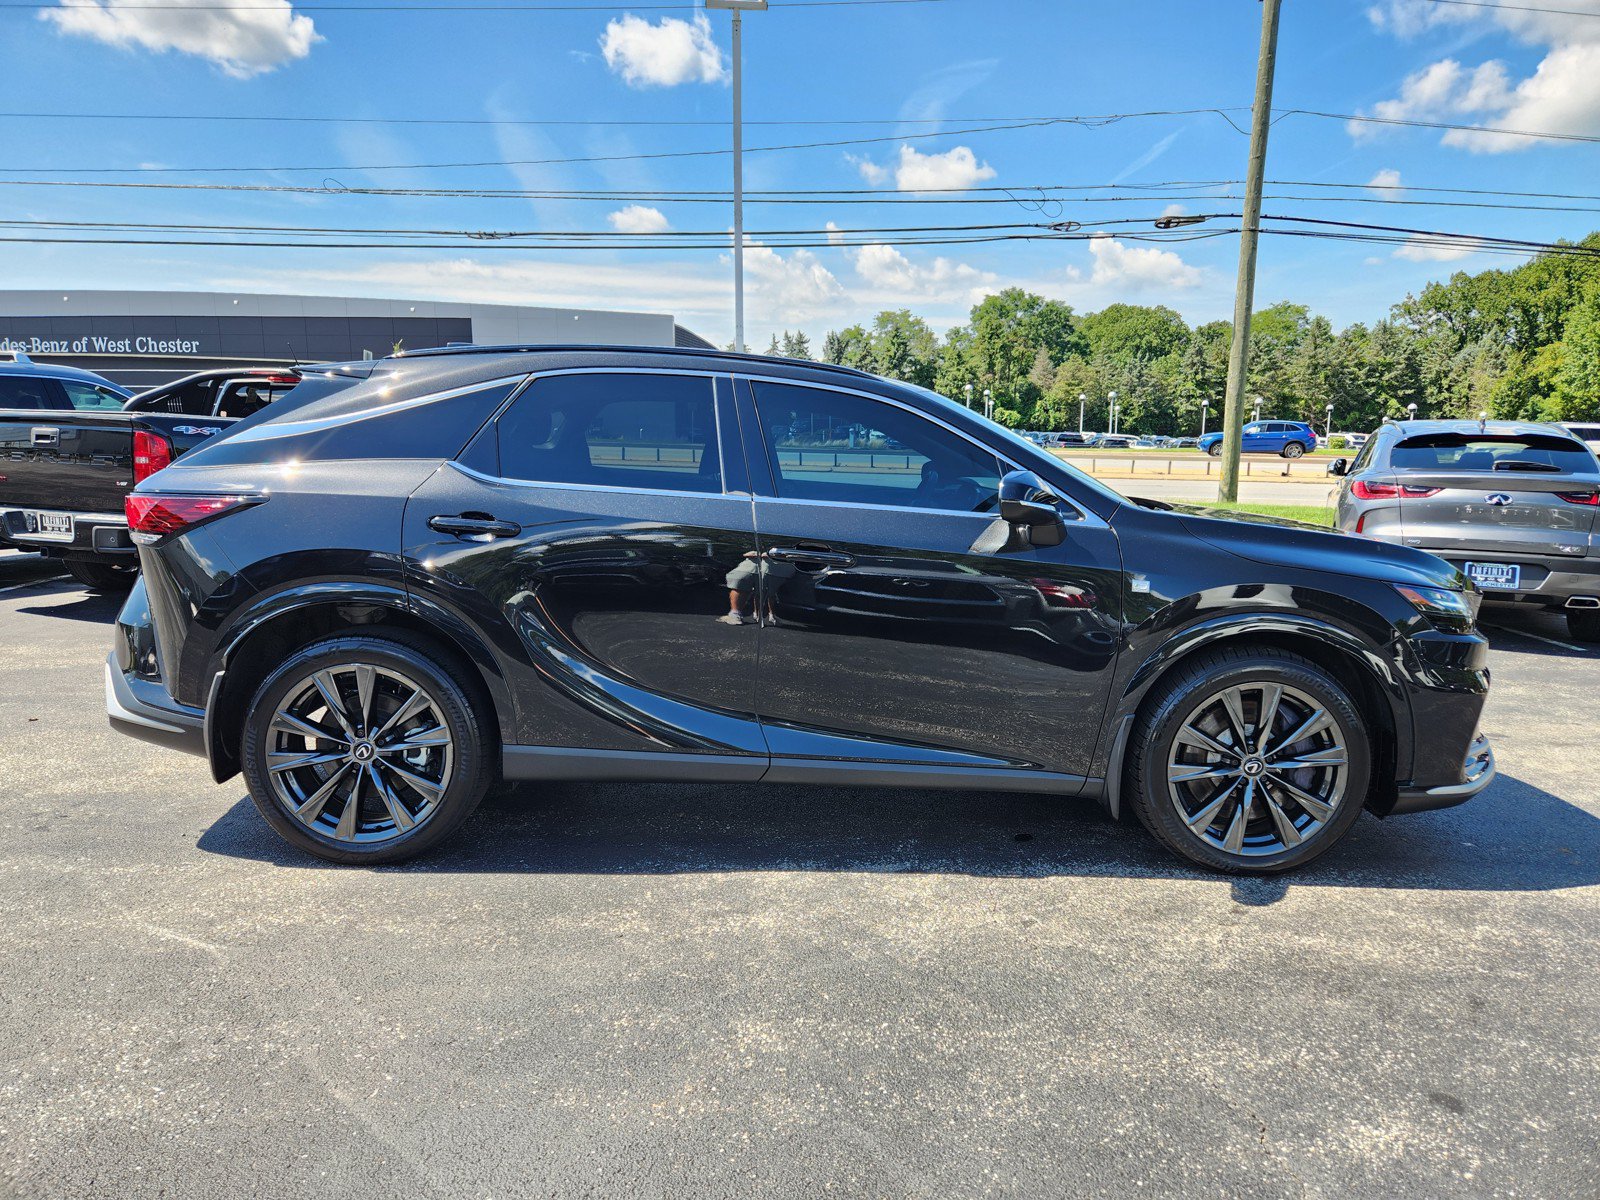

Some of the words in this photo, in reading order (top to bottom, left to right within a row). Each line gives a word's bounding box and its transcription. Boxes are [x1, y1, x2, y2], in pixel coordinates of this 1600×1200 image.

[72, 336, 88, 353] of
[91, 336, 132, 353] West
[135, 336, 200, 353] Chester
[1471, 566, 1512, 577] INFINITI
